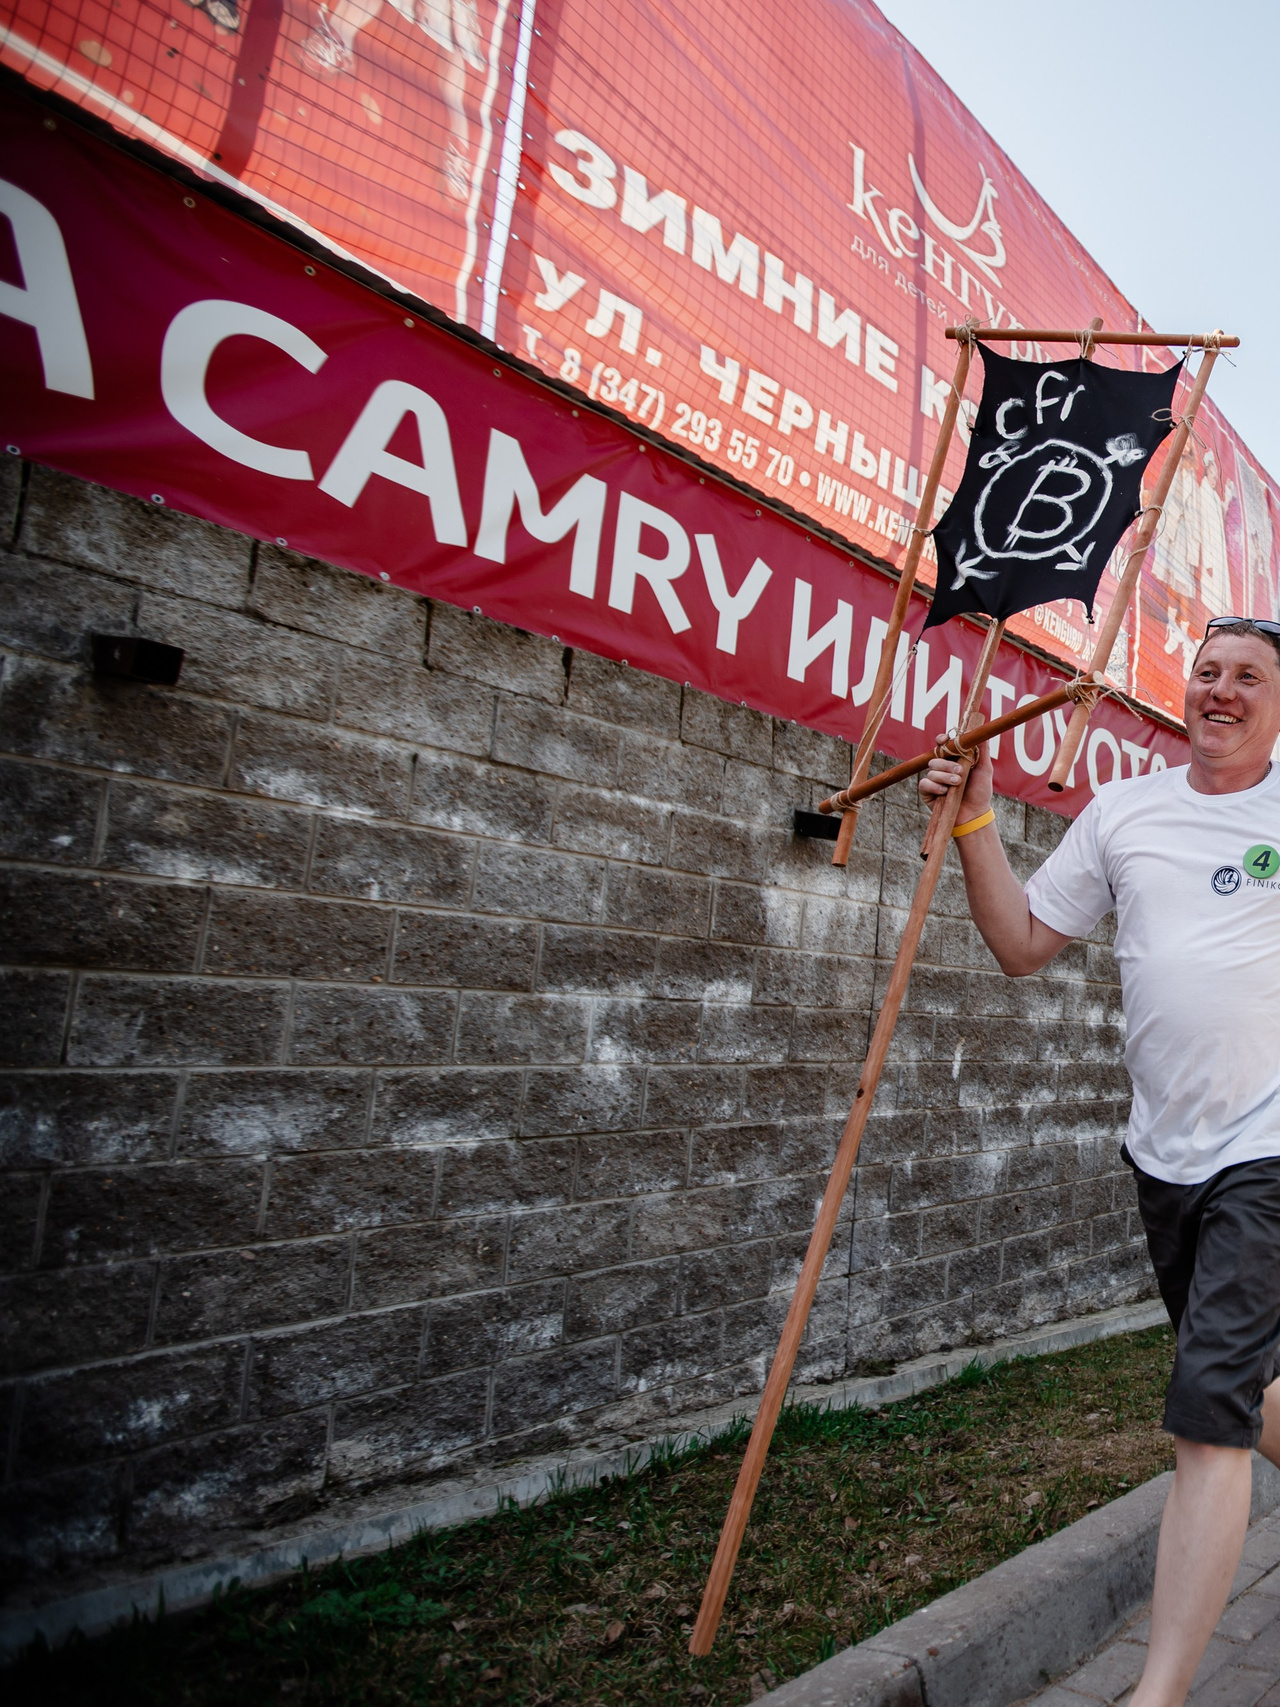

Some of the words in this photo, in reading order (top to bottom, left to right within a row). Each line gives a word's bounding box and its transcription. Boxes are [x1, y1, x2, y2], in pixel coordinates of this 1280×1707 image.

[533, 253, 663, 368] УЛ.
[548, 129, 899, 393] ЗИМНИЕ
[850, 235, 890, 275] для
[894, 271, 948, 324] детей
[559, 347, 582, 383] 8
[587, 361, 666, 431] (347)
[671, 402, 723, 452] 293
[727, 428, 761, 470] 55
[765, 446, 795, 486] 70
[161, 299, 773, 655] CAMRY
[786, 577, 963, 740] ИЛИ
[1252, 850, 1271, 872] 4
